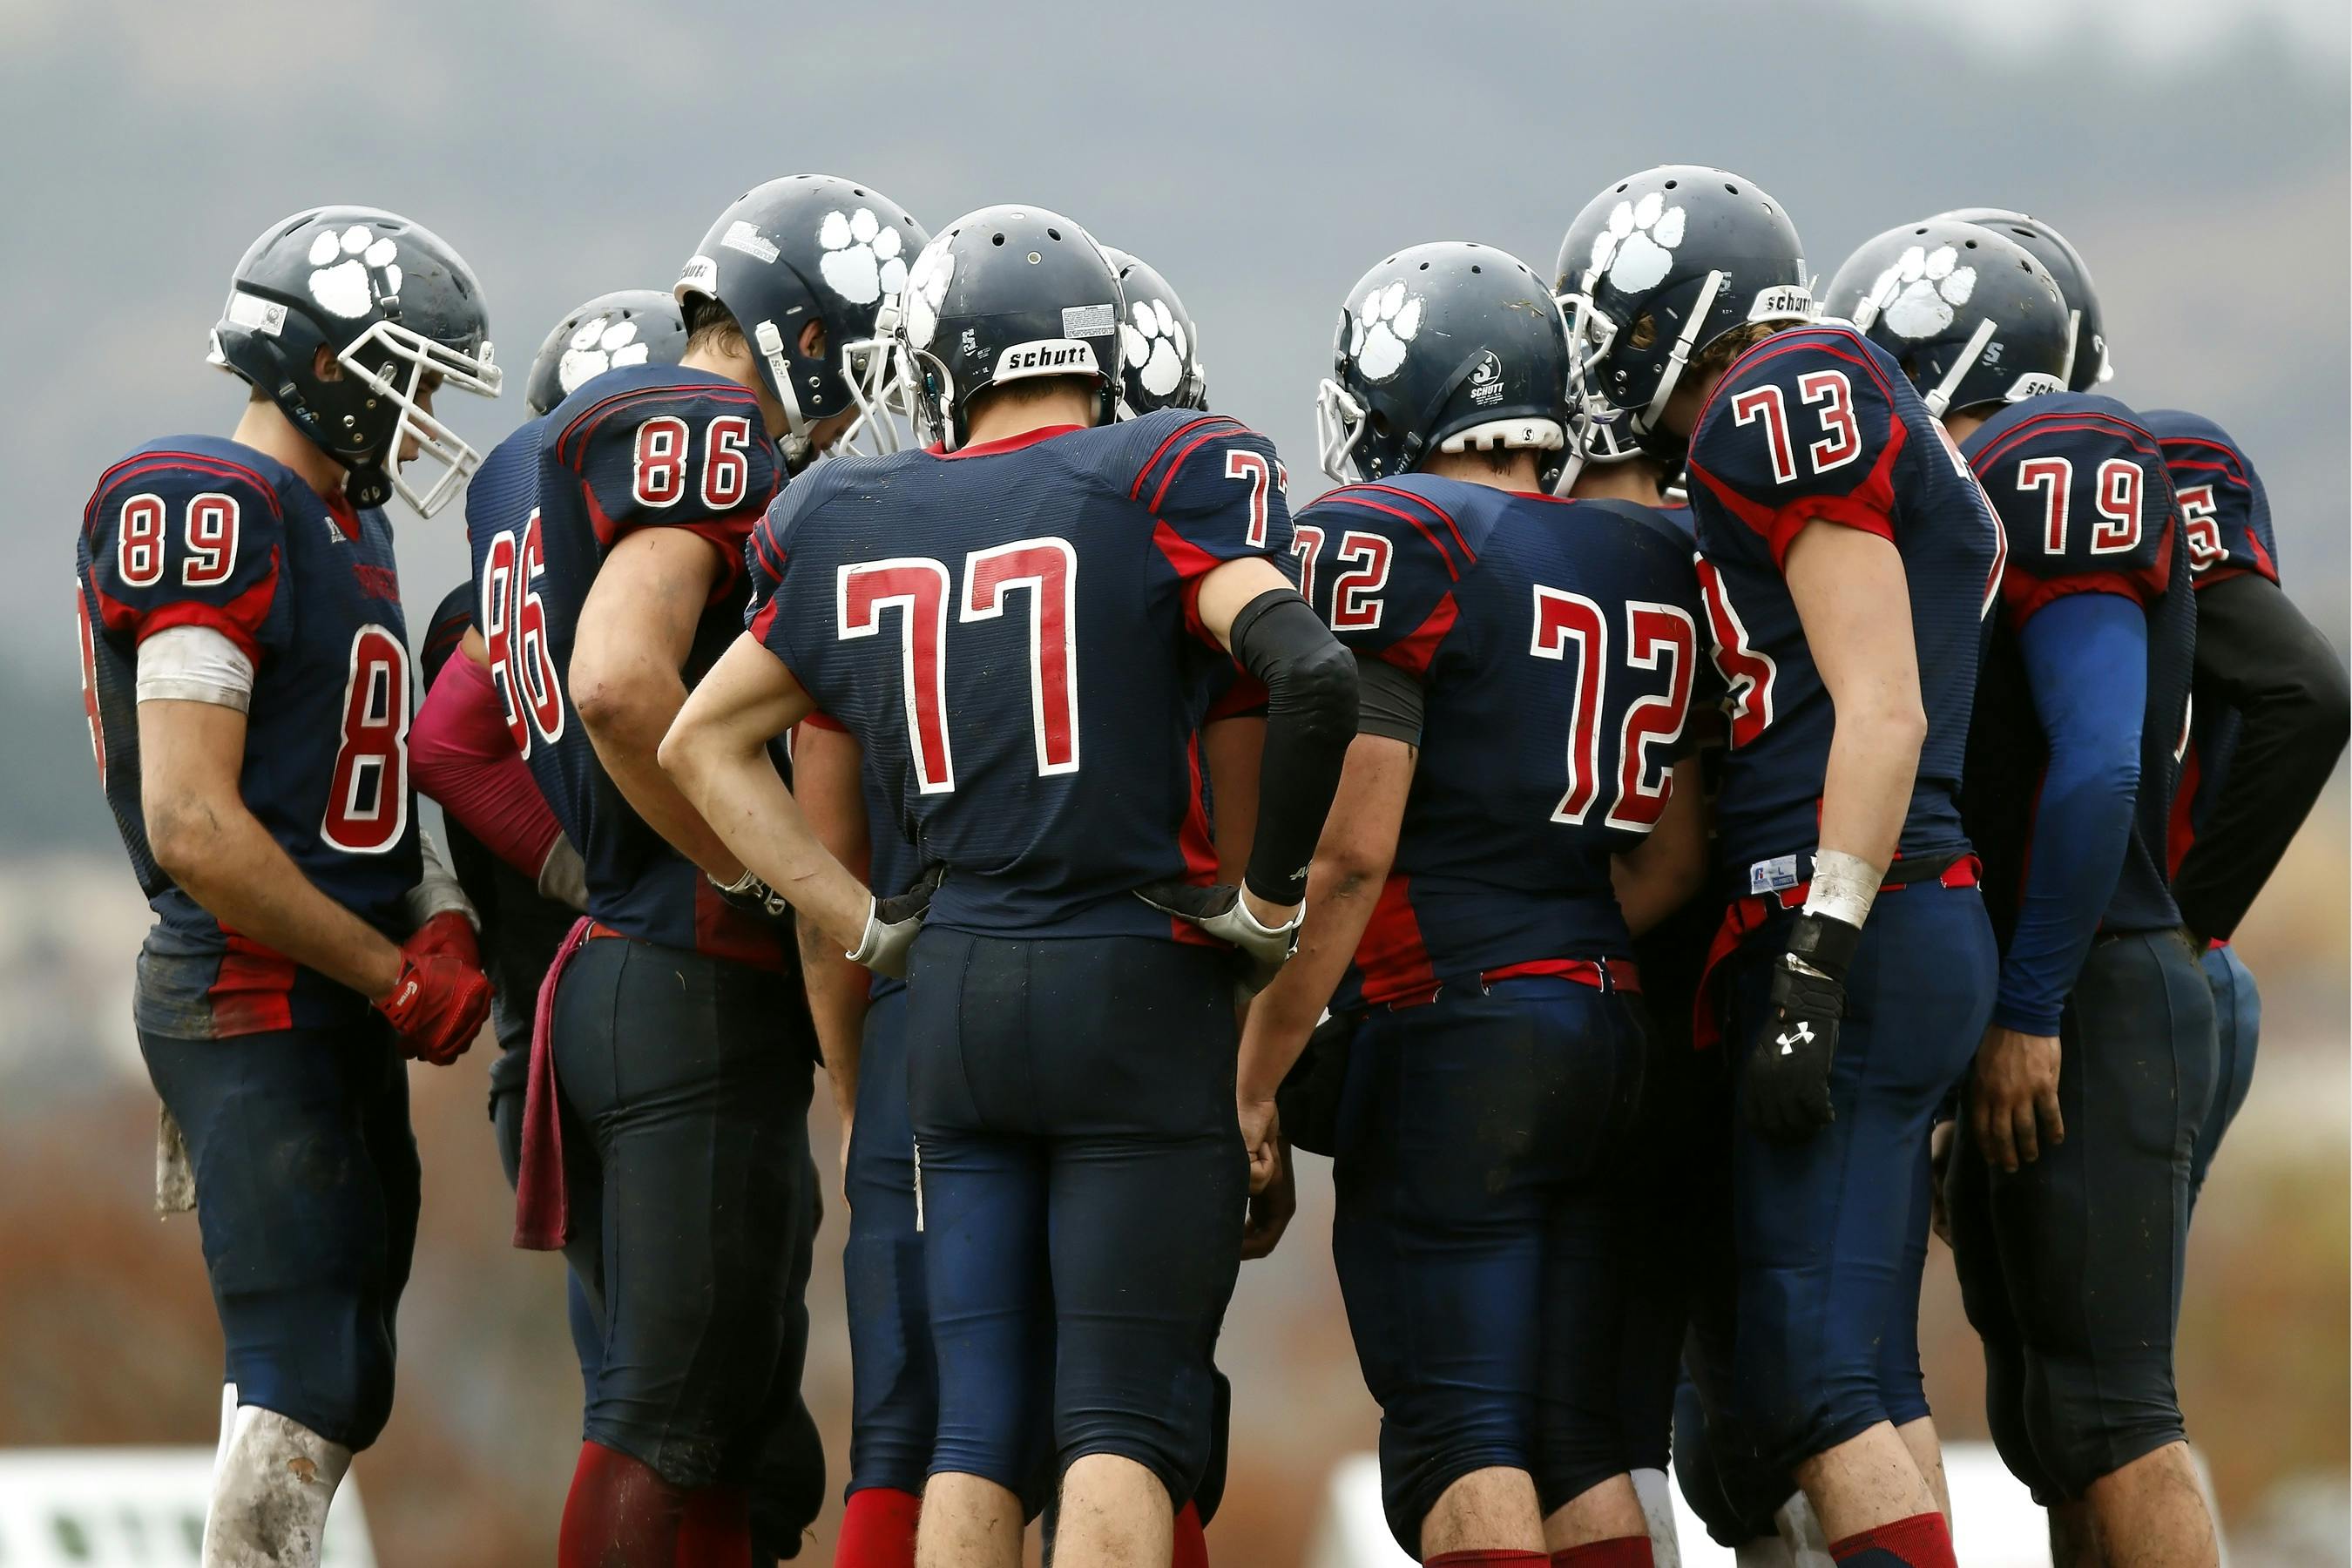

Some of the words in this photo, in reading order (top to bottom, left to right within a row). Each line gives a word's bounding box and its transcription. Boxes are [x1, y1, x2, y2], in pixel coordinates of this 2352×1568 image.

[1009, 347, 1086, 369] schutt
[1470, 382, 1504, 399] SCHUTT
[632, 416, 751, 510] 86
[1731, 369, 1862, 484] 73
[118, 492, 240, 587] 89
[2017, 456, 2144, 555] 79
[1290, 524, 1394, 632] 72
[482, 506, 565, 760] 86
[836, 536, 1080, 794] 77
[1530, 583, 1697, 833] 72
